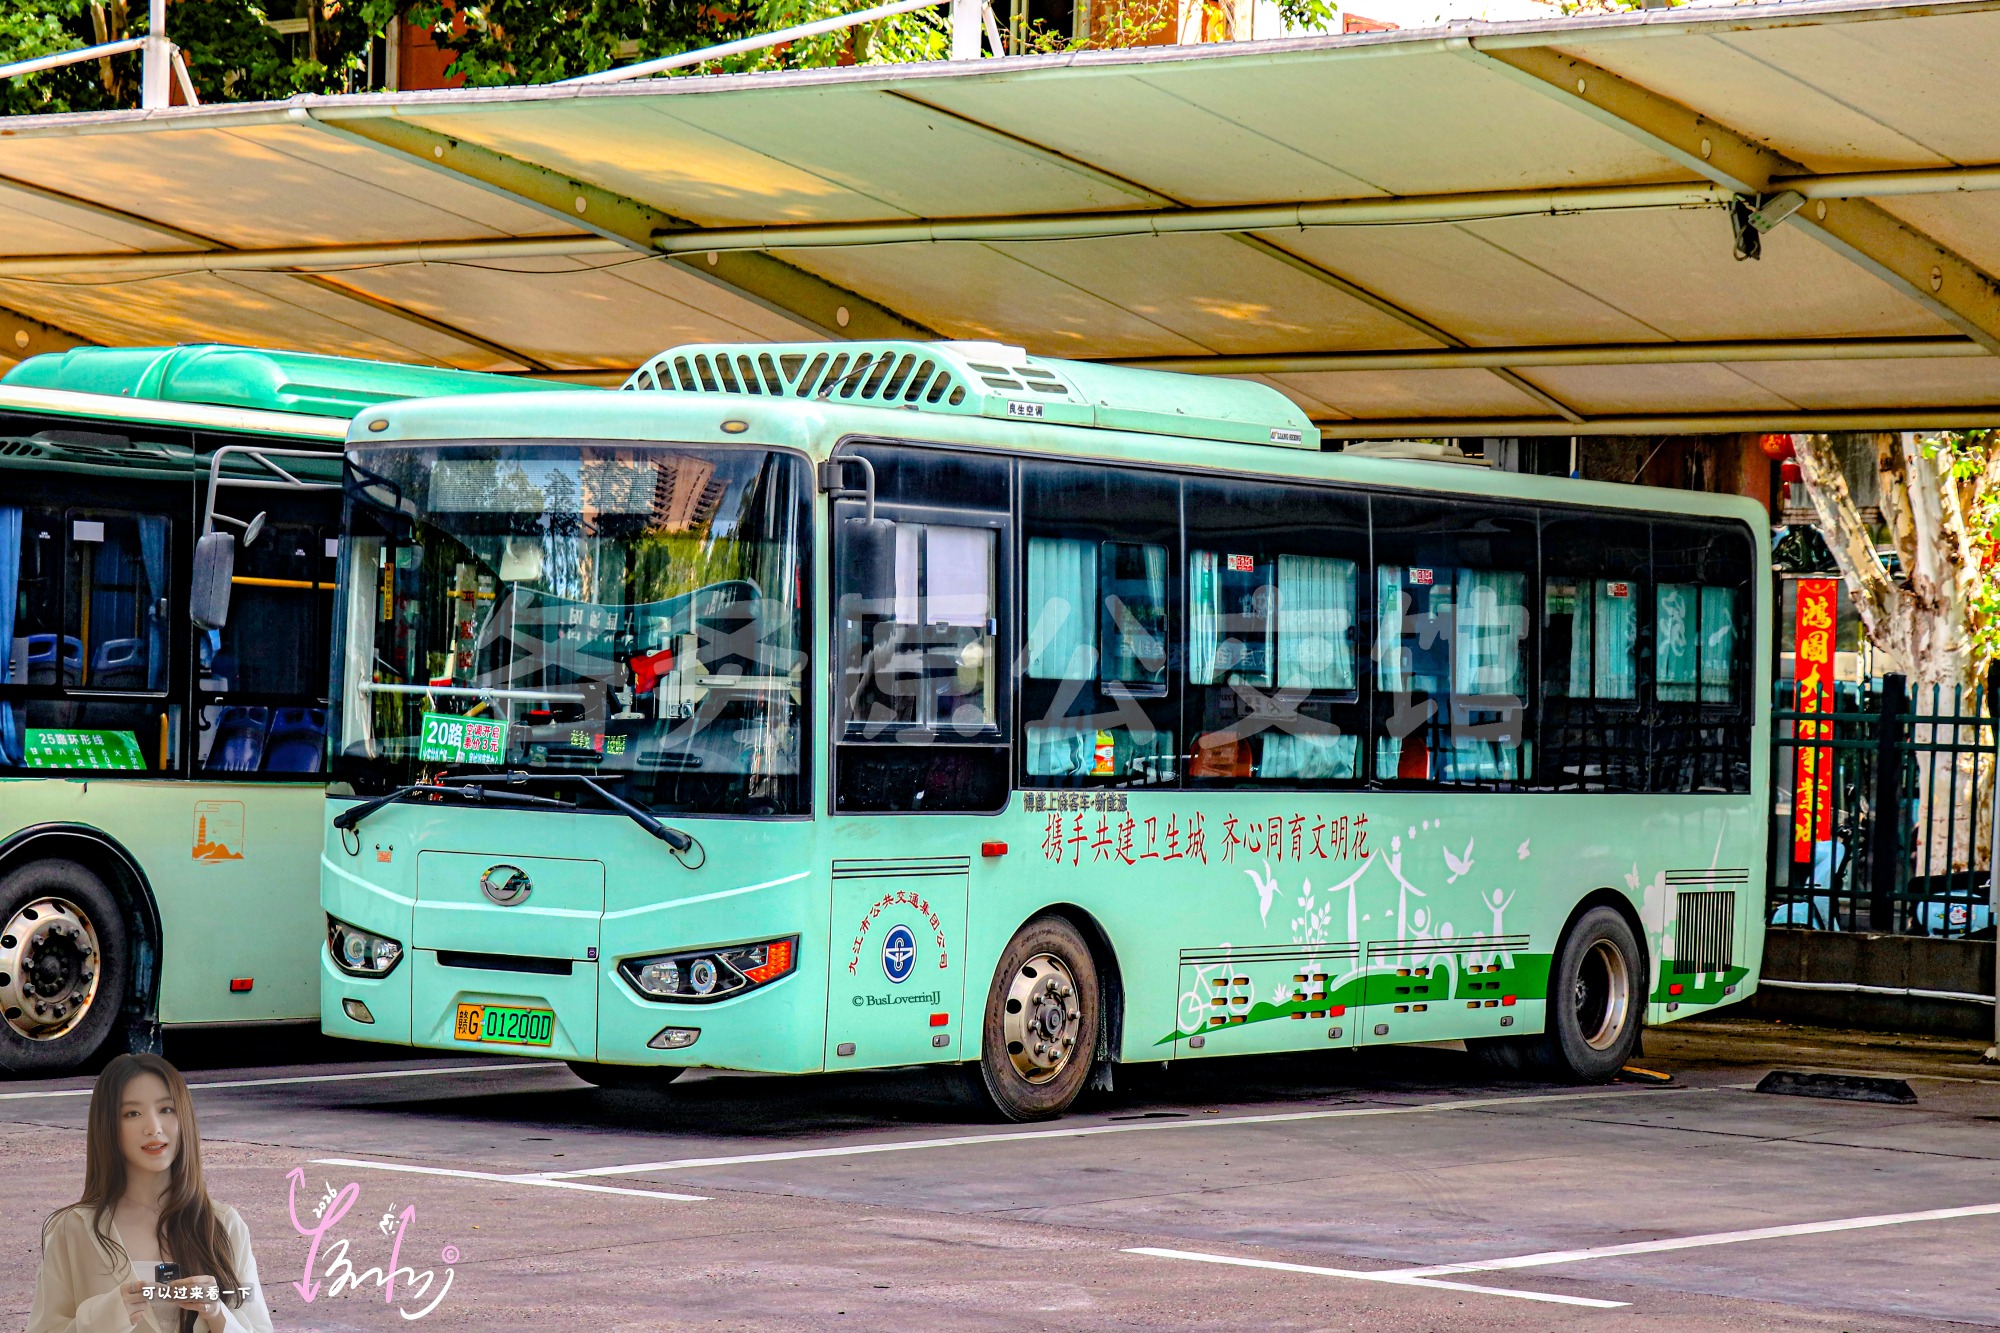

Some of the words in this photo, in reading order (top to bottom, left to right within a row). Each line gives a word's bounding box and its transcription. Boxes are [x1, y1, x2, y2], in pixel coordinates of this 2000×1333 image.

[1009, 402, 1043, 417] 良生空调
[426, 721, 463, 748] 20路
[465, 723, 501, 739] 空调开启
[38, 733, 104, 746] 25路环形线
[463, 736, 499, 752] 票价3元
[1040, 811, 1208, 867] 携手共建卫生城
[1221, 812, 1370, 864] 齐心同育文明花
[848, 890, 948, 976] 九江市公共交通集团公司
